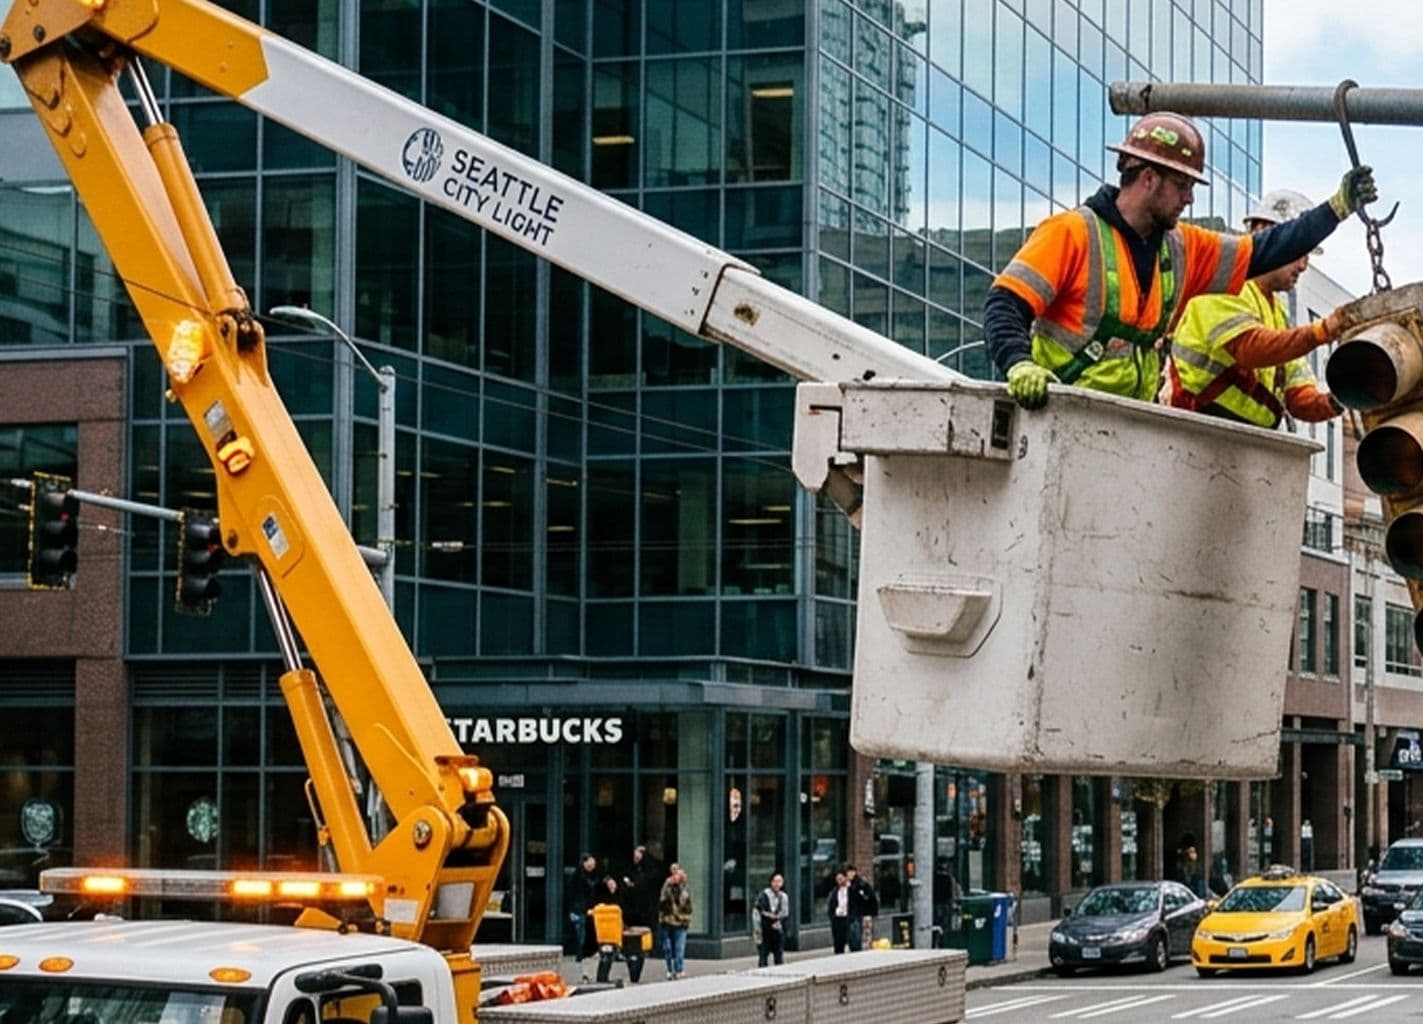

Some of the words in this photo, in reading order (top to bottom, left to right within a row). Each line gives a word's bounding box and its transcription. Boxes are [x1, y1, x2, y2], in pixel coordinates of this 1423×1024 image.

[443, 178, 490, 213] CITY
[492, 202, 555, 246] LIGHT
[451, 149, 565, 223] SEATTLE
[446, 718, 623, 743] TARBUCKS
